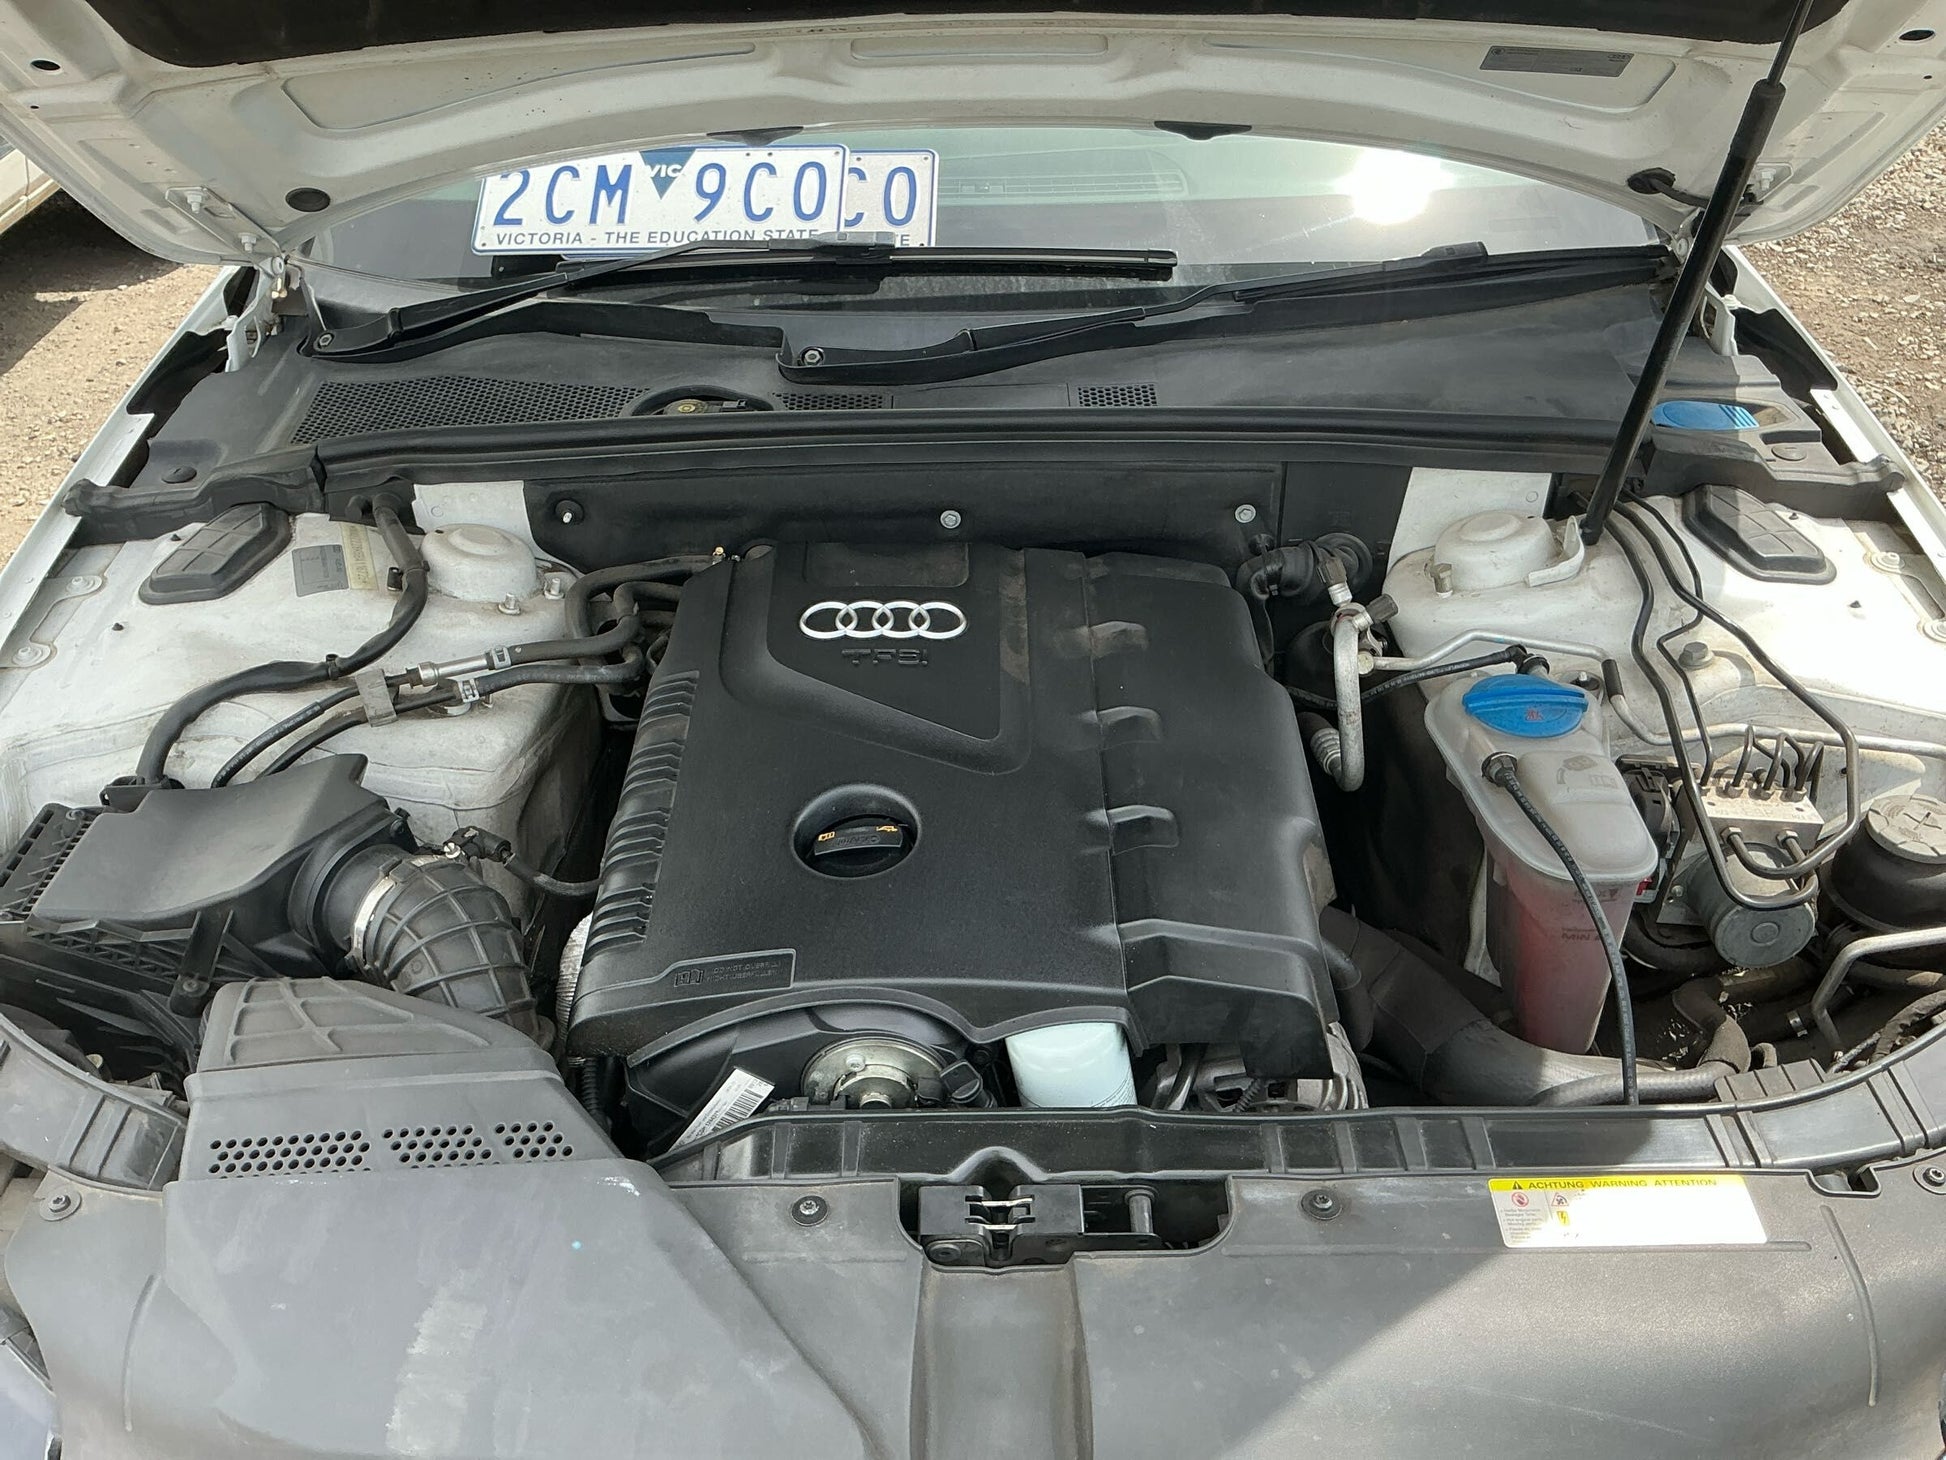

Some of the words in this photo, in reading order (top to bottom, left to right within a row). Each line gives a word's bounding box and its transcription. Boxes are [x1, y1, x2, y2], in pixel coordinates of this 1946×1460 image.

[645, 164, 683, 177] VIC
[493, 165, 632, 225] 2CM
[496, 232, 583, 245] VICTORIA
[605, 231, 640, 244] THE
[647, 230, 755, 244] EDUCATION
[763, 229, 819, 240] STATE
[1528, 1181, 1585, 1189] ACHTUNG
[1590, 1179, 1648, 1188] WARNING
[1654, 1179, 1718, 1187] ATTENTION
